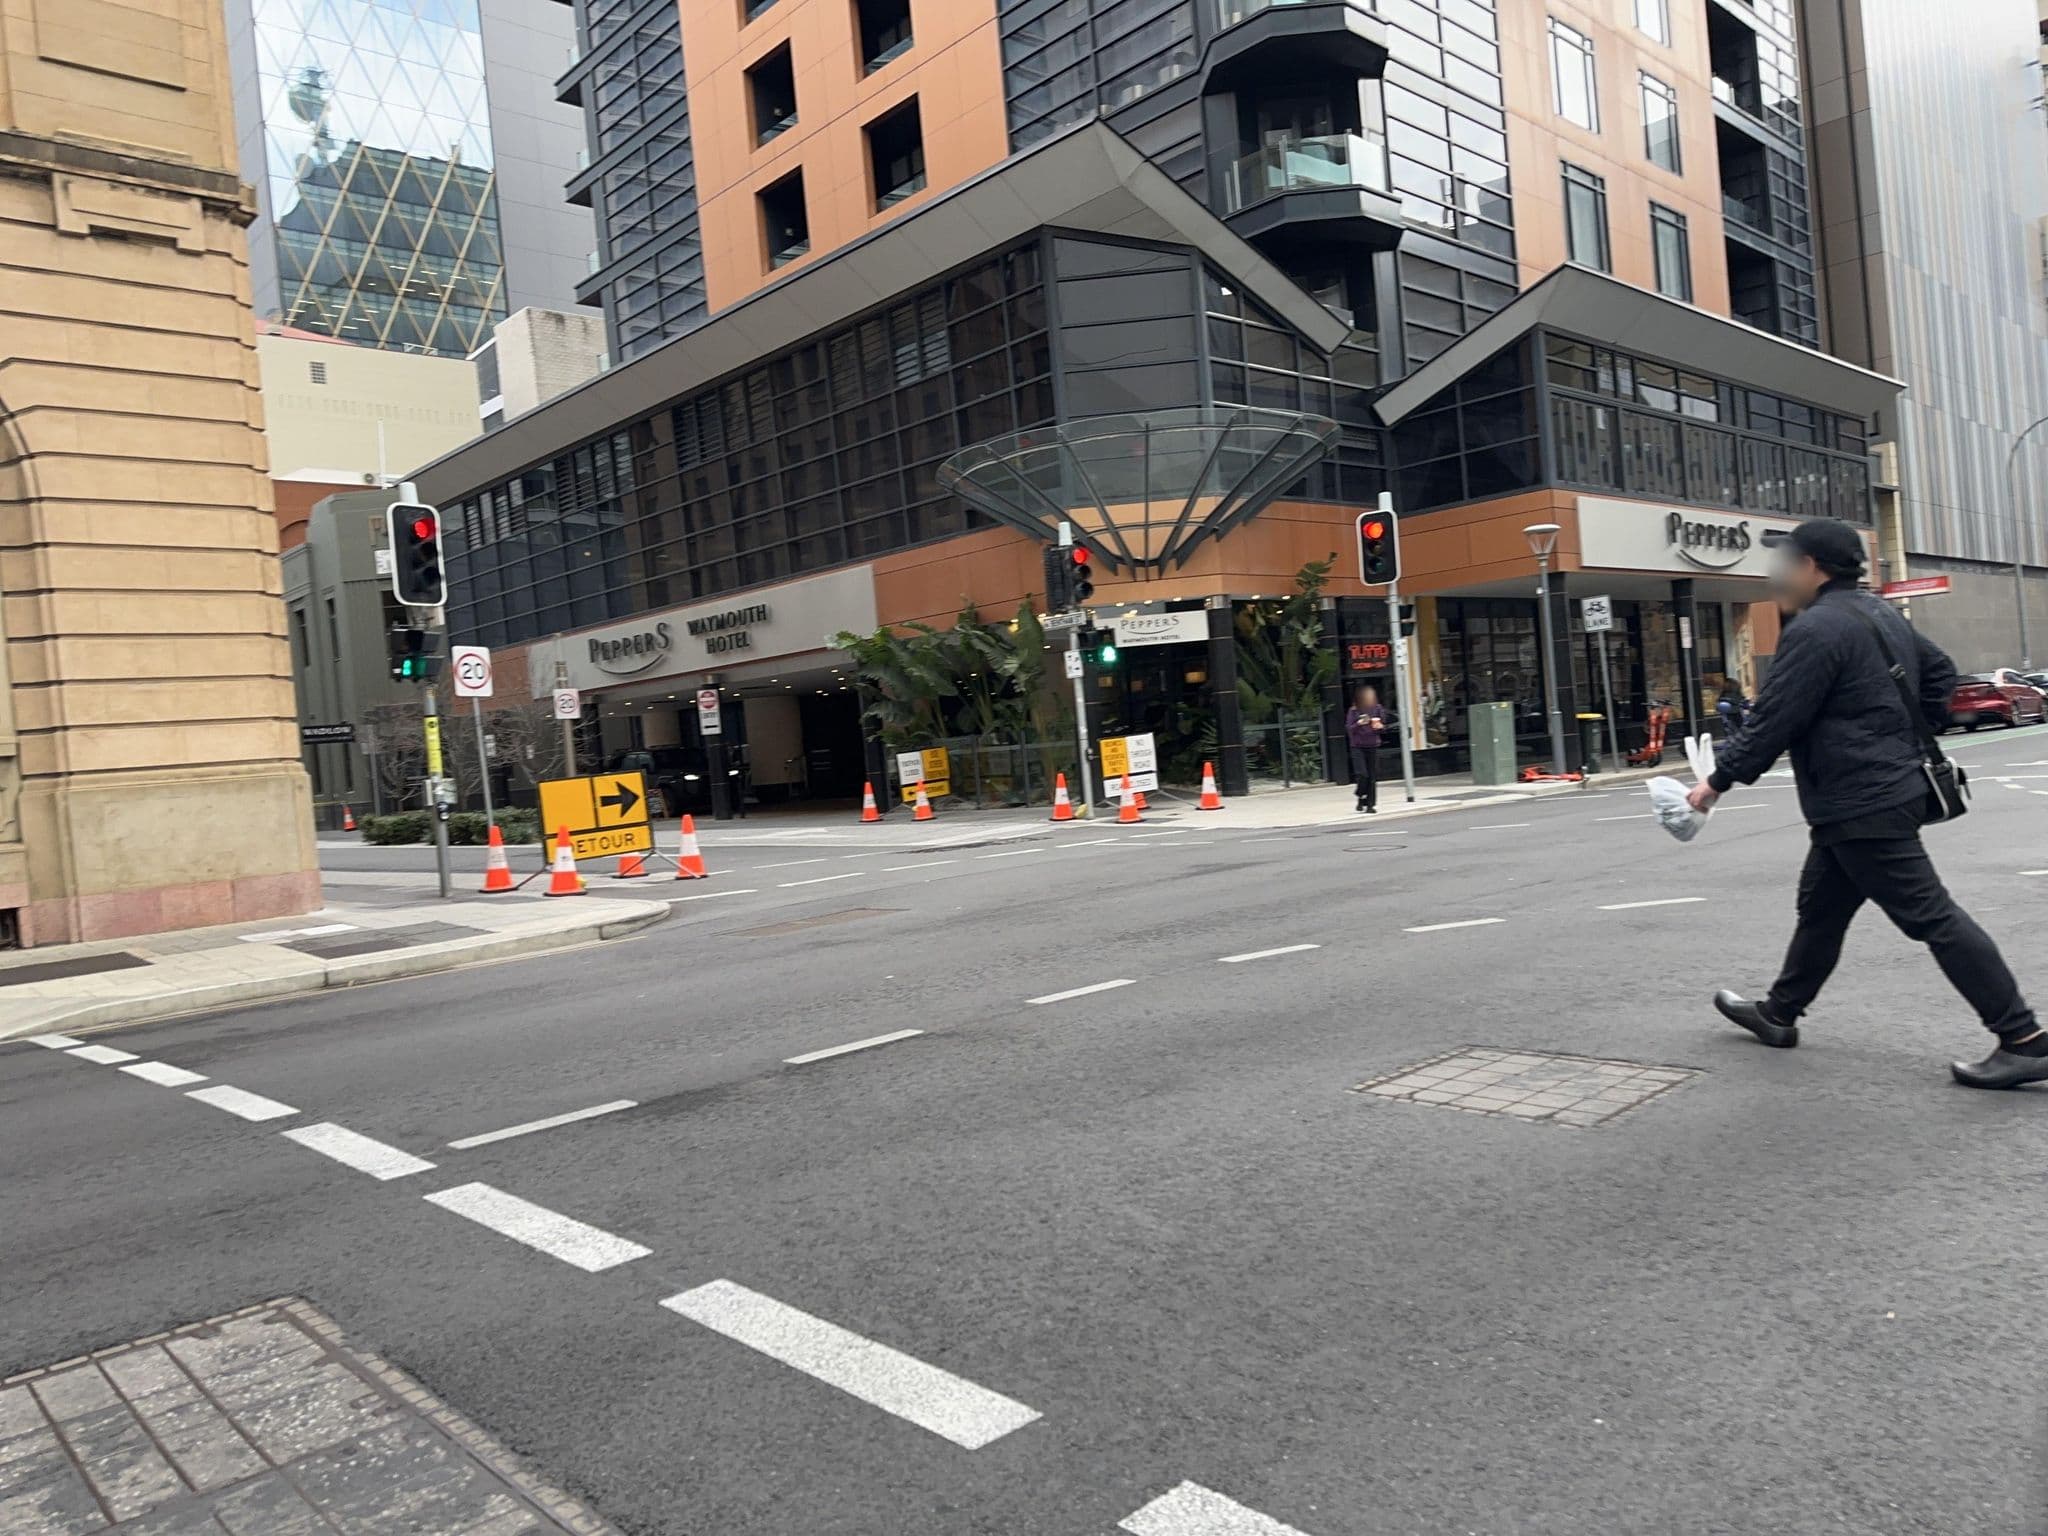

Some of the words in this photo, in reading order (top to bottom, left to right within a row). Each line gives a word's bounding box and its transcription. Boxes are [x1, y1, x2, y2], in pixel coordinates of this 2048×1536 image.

[1666, 512, 1750, 550] PEPPERS
[687, 604, 768, 636] WAYMOUTH
[1121, 615, 1179, 629] PEPPERS
[1585, 617, 1609, 628] LANE
[588, 622, 671, 663] PEPPERS
[705, 631, 750, 654] HOTEL
[1349, 643, 1389, 659] TUTTO
[461, 662, 485, 680] 20
[560, 698, 574, 709] 20
[571, 832, 636, 855] ETOUR
